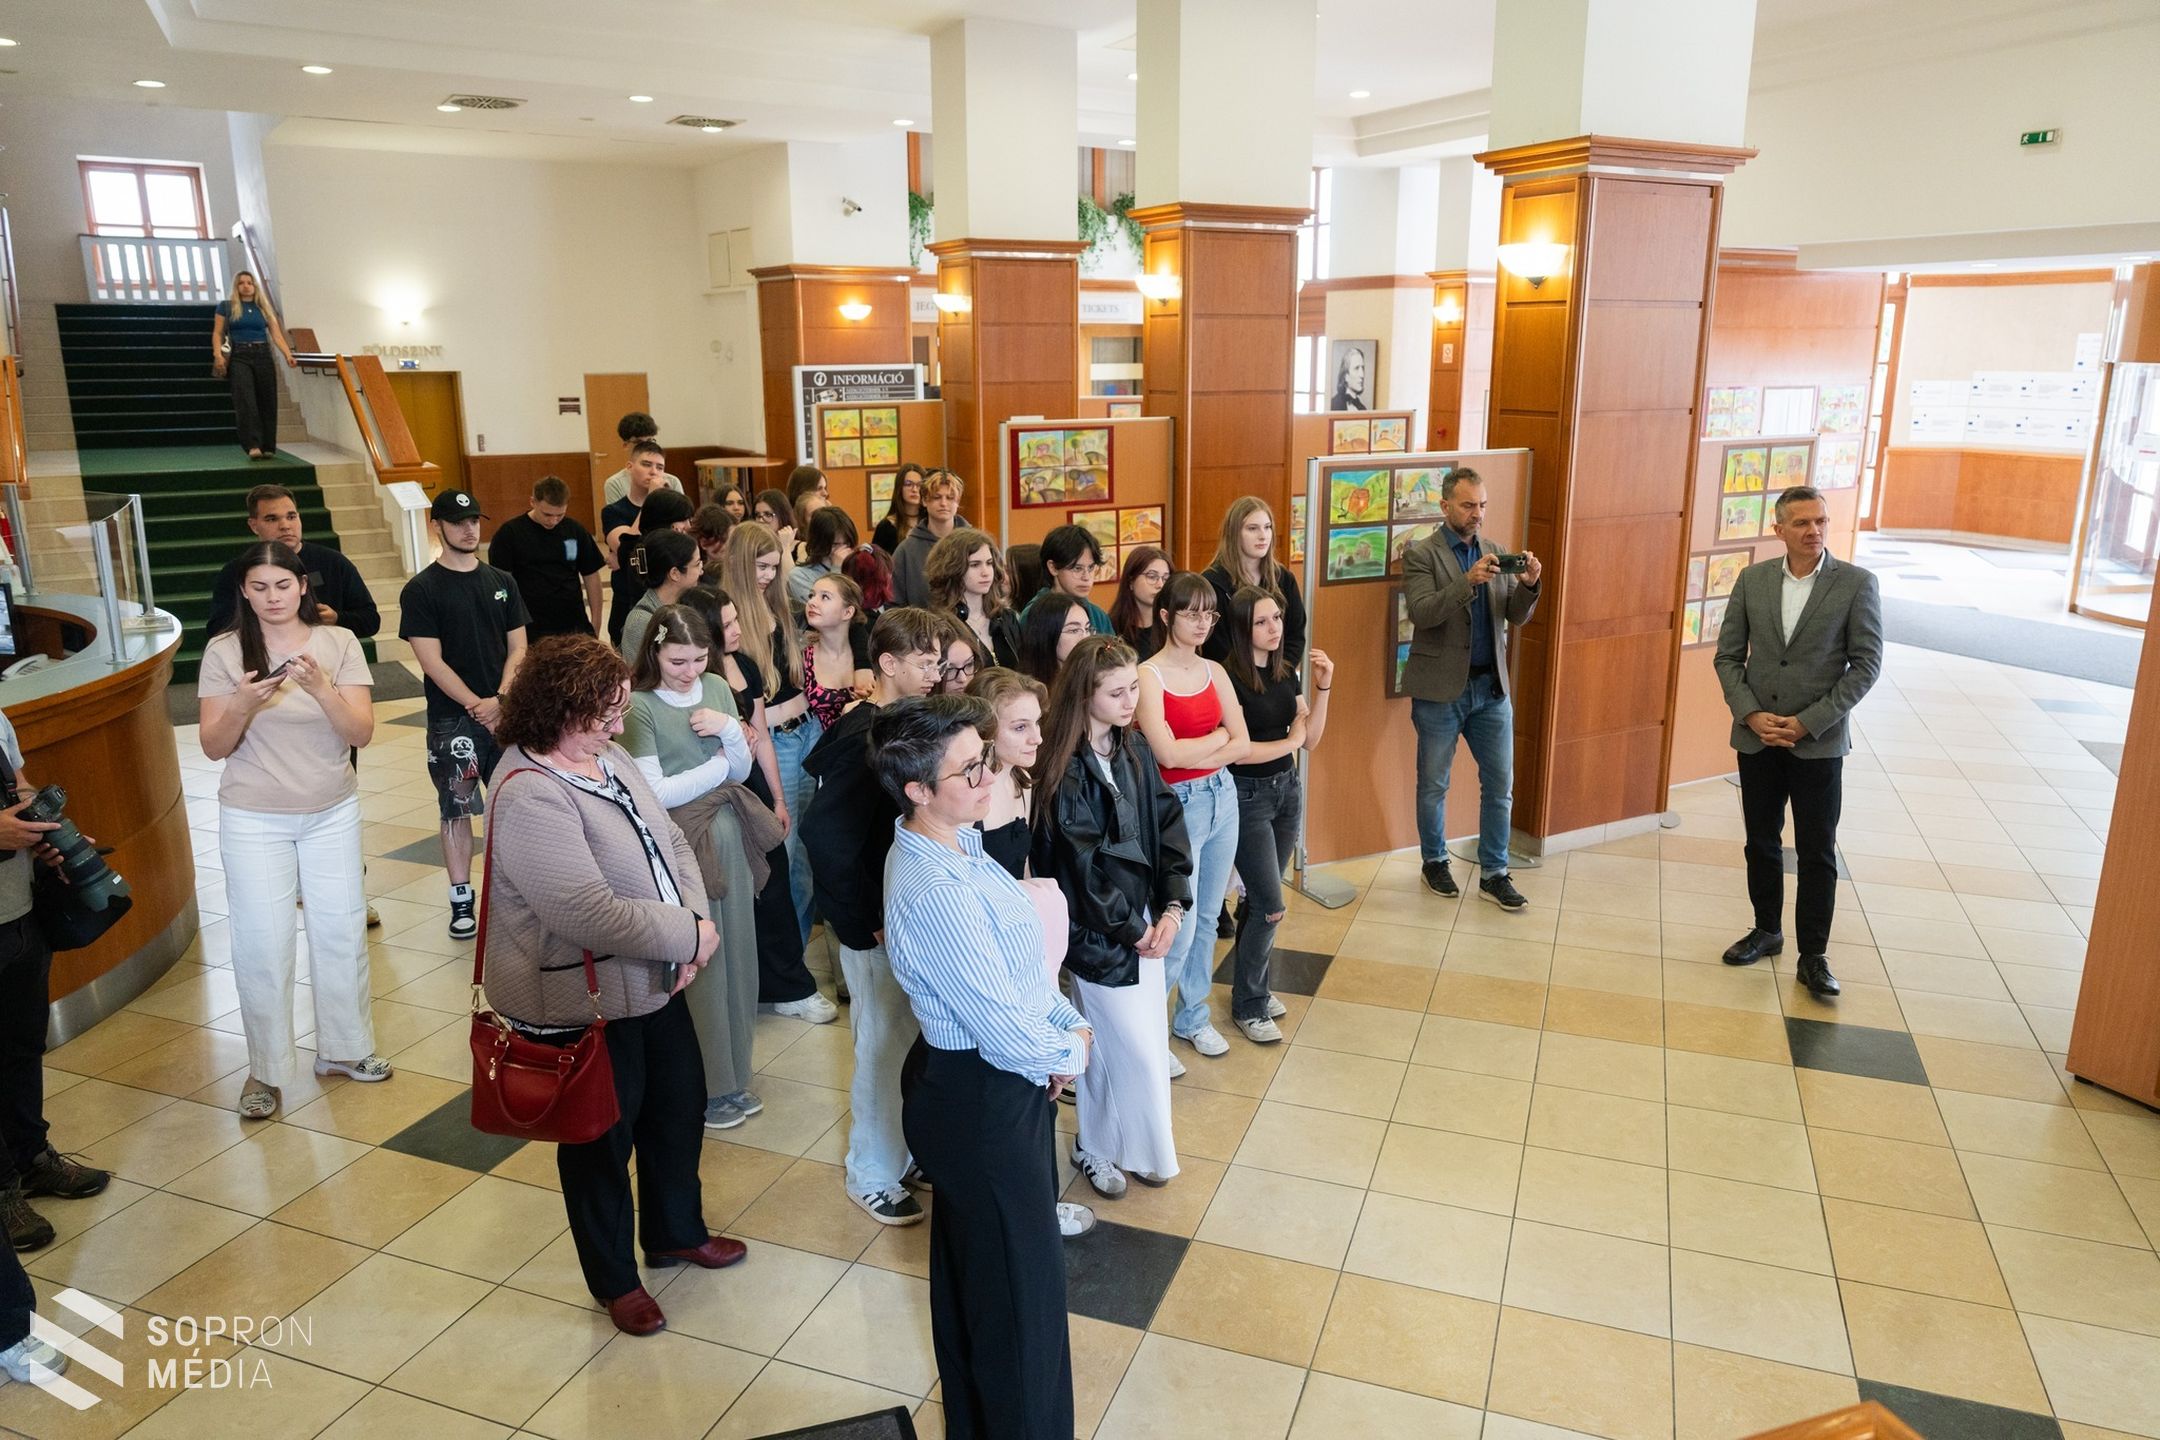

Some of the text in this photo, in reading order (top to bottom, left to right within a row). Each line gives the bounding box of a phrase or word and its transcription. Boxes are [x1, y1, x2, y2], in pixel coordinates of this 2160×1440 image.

[1081, 303, 1120, 313] TICKETS
[362, 343, 442, 357] FÖLDSZINT
[833, 372, 905, 386] INFORMÁCIÓ
